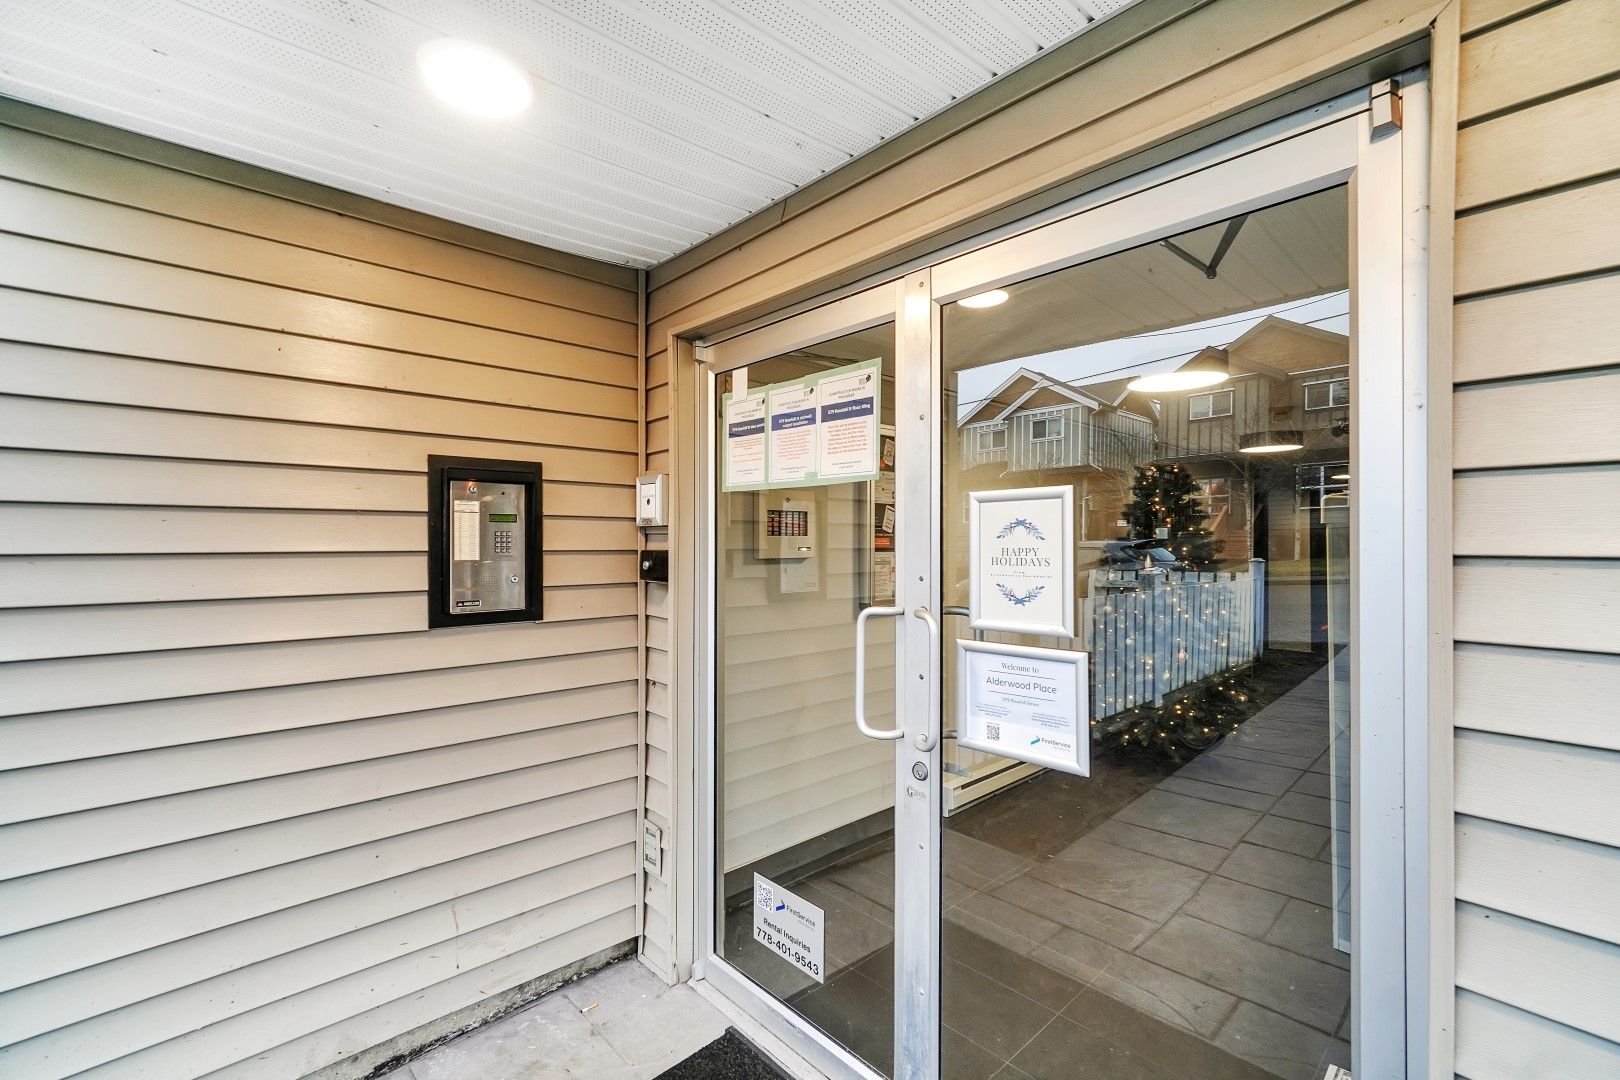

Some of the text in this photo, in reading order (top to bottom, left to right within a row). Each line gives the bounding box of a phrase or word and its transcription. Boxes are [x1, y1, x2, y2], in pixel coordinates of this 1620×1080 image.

[1001, 547, 1039, 557] HAPPY
[991, 556, 1051, 567] HOLIDAYS
[1001, 662, 1039, 674] Welcome to
[986, 676, 1057, 694] Alderwood Place
[1041, 737, 1071, 749] FirstService
[763, 917, 782, 934] Rental
[783, 930, 811, 953] Inquiries
[756, 926, 819, 976] 778-401-9543
